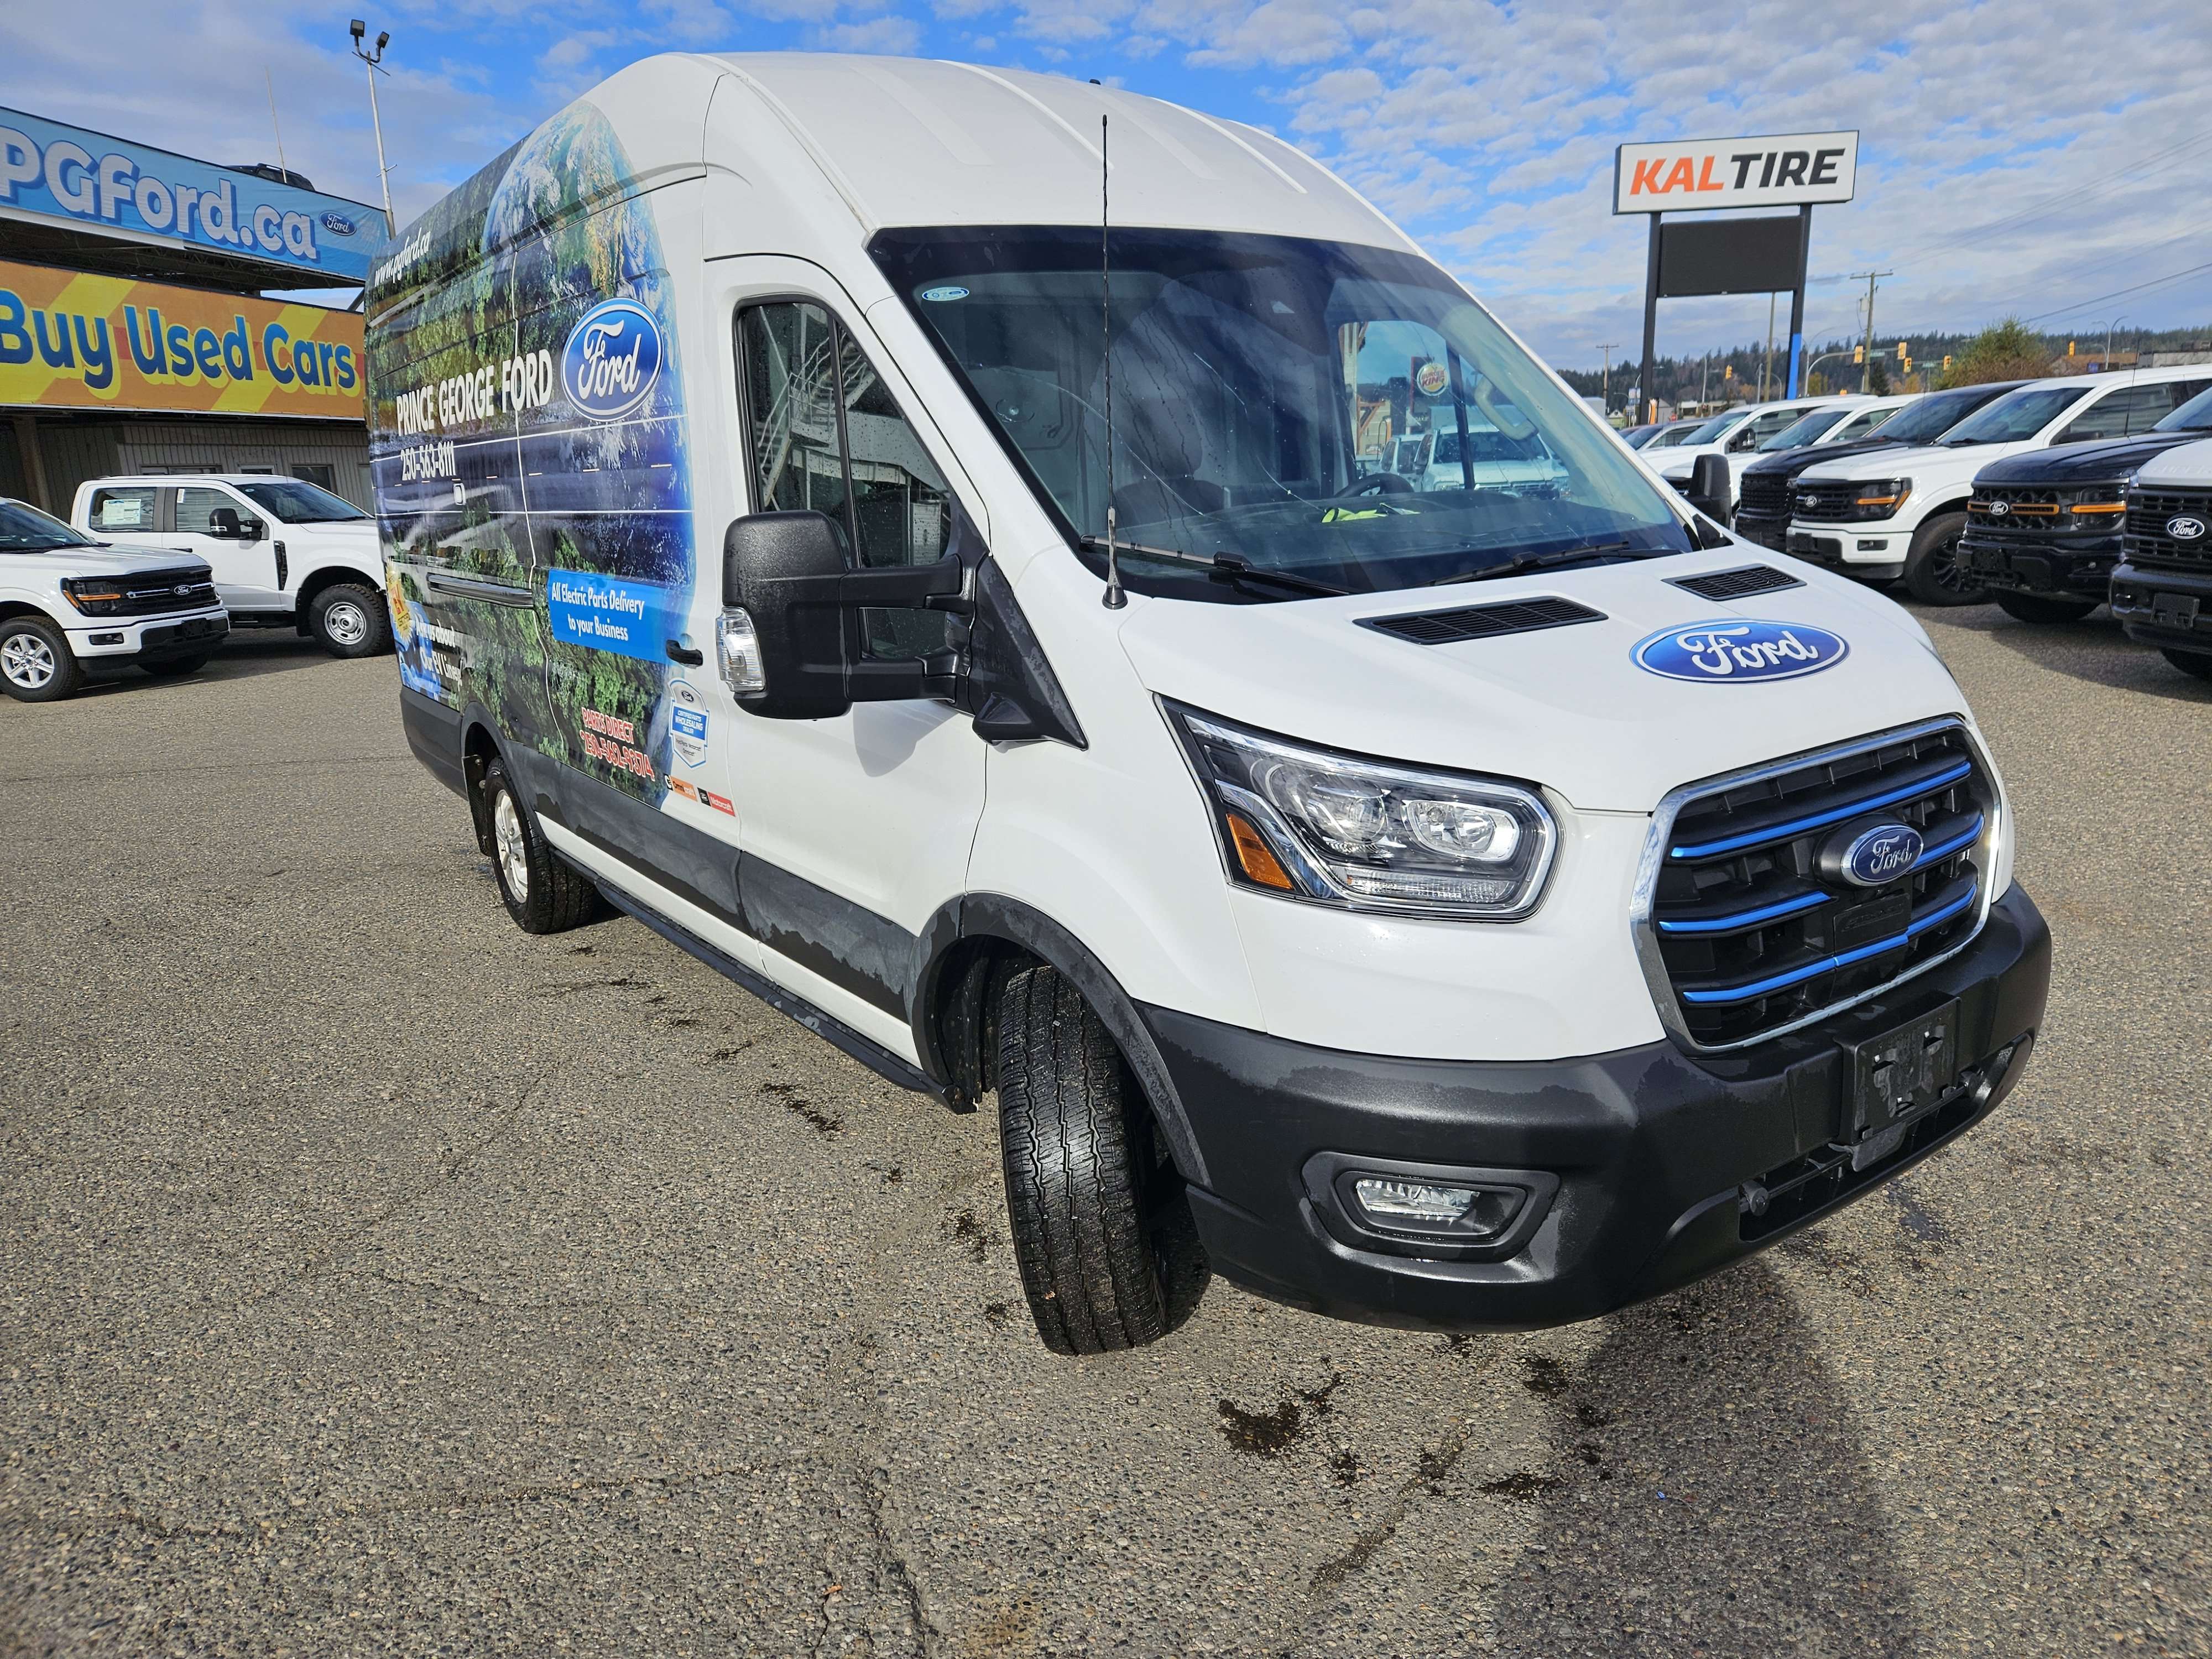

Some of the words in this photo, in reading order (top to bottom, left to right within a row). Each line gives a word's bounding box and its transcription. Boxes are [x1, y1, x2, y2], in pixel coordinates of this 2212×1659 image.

[1629, 155, 1725, 195] KAL
[1730, 148, 1846, 190] TIRE
[326, 213, 349, 233] Ford
[374, 226, 431, 287] www.pgford.ca
[0, 289, 113, 389] Buy
[123, 305, 254, 382] Used
[263, 324, 356, 389] Cars
[578, 319, 642, 400] Ford
[396, 384, 435, 436] PRINCE
[439, 364, 495, 427] GEORGE
[502, 348, 553, 414] FORD
[400, 440, 456, 481] 250-563-8111
[551, 582, 561, 602] All
[561, 583, 587, 607] Electric
[588, 586, 608, 609] Parts
[609, 589, 645, 620] Delivery
[436, 618, 456, 648] about
[567, 613, 576, 631] to
[576, 618, 593, 637] your
[594, 615, 629, 641] Business
[432, 650, 443, 676] EV
[1676, 625, 1819, 675] Ford
[581, 707, 607, 735] PARTS
[604, 714, 635, 745] DIRECT
[579, 729, 656, 782] 250-562-9374
[1870, 834, 1913, 874] Ford
